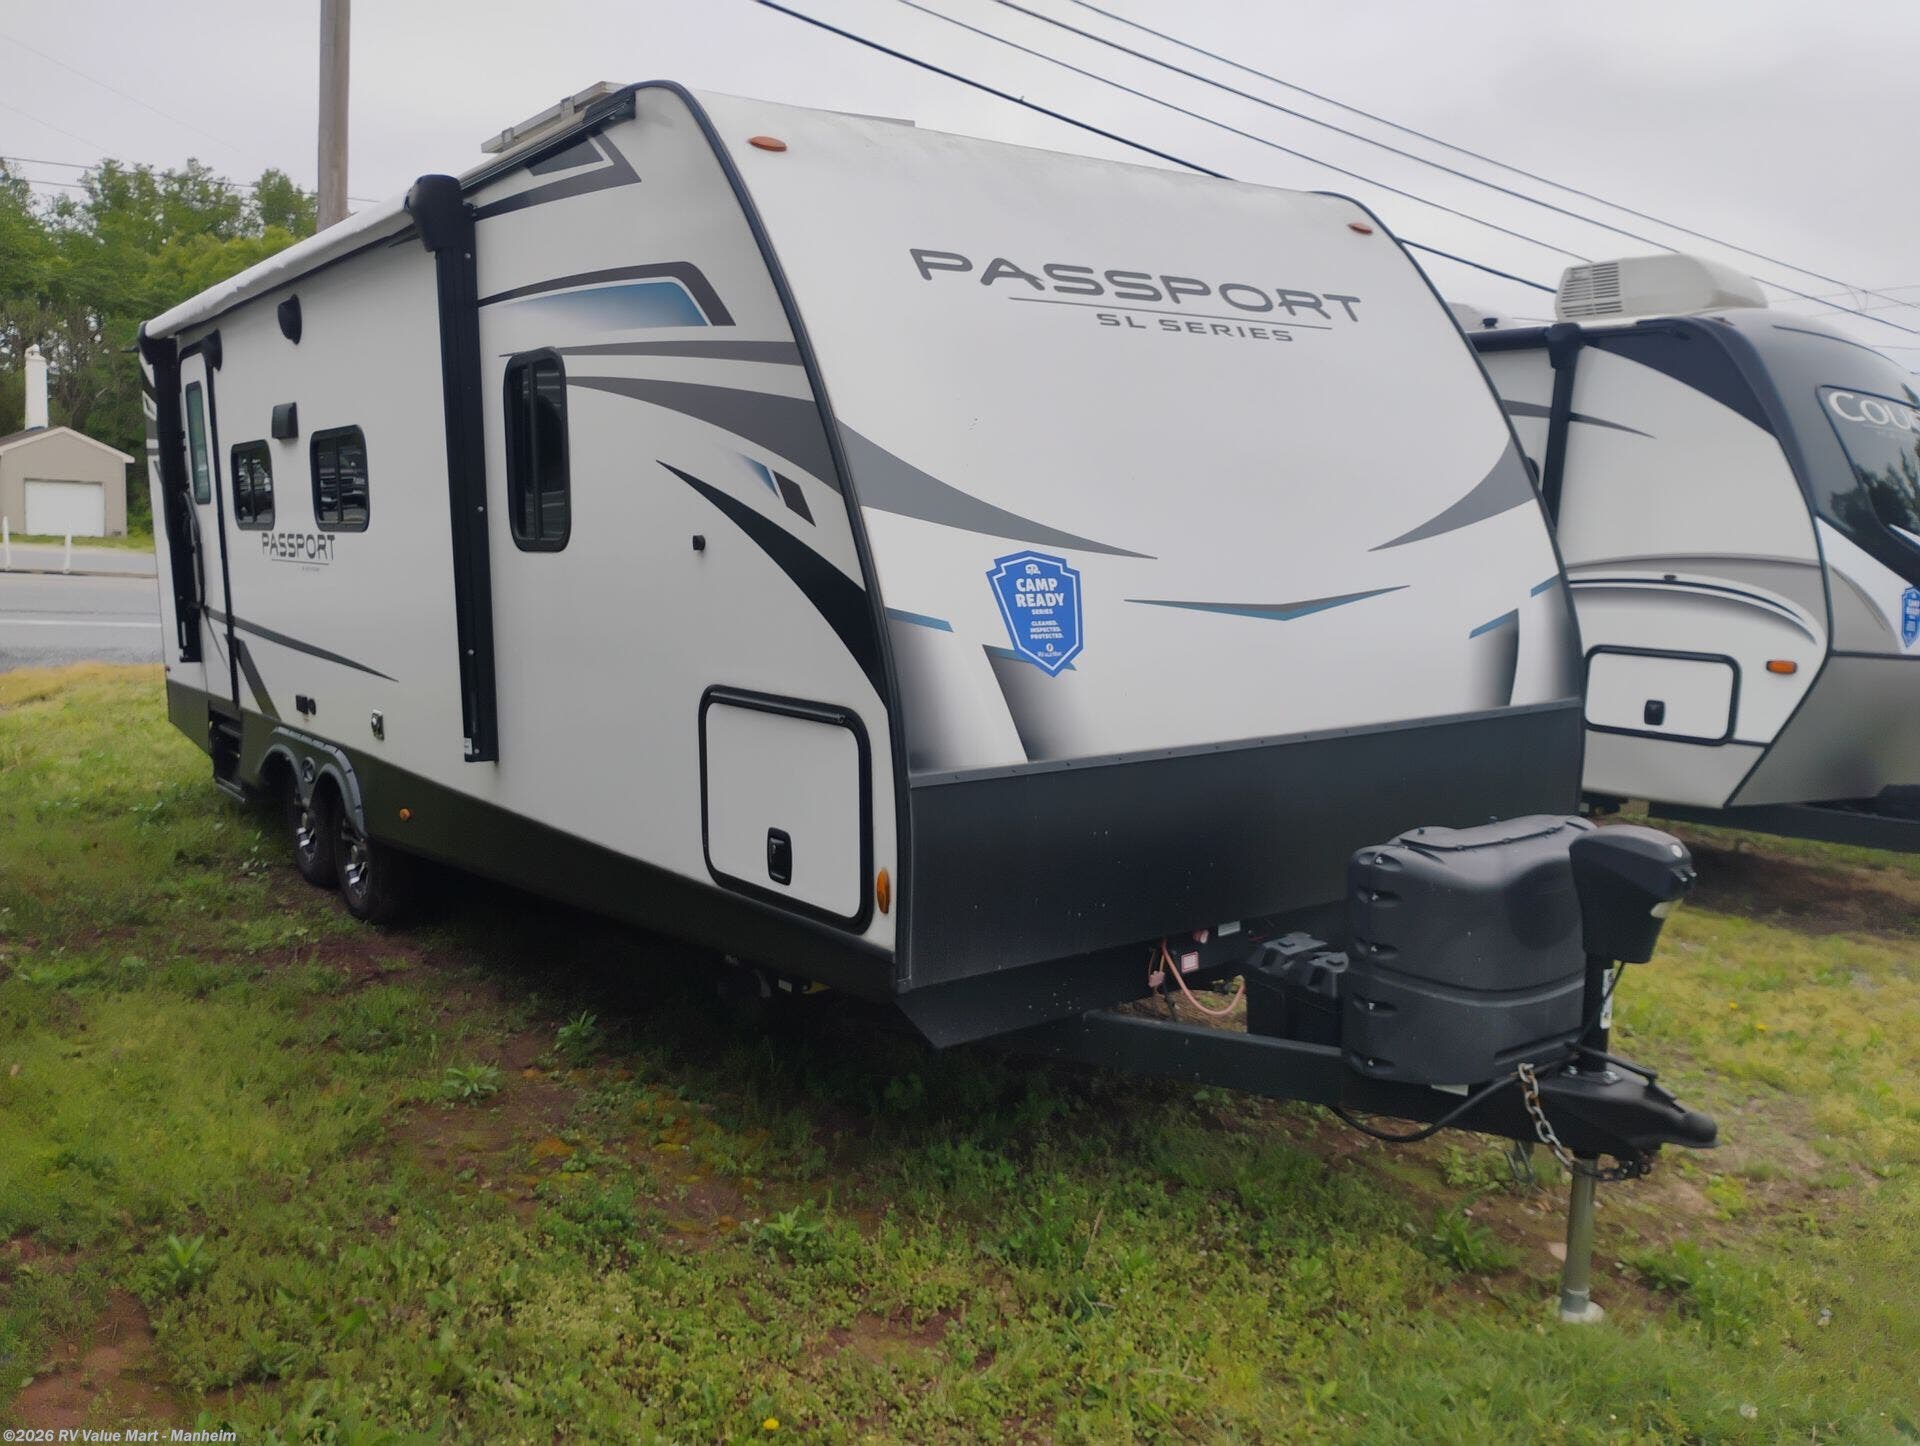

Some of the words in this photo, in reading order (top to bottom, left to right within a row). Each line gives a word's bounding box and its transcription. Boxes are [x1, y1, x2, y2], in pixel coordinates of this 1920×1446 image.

[909, 248, 1362, 323] PASSPORT
[1096, 313, 1147, 330] SL
[1158, 318, 1294, 342] SERIES
[1828, 391, 1920, 431] COU
[261, 532, 336, 561] PASSPORT
[1015, 578, 1058, 593] CAMP
[1015, 592, 1065, 608] READY
